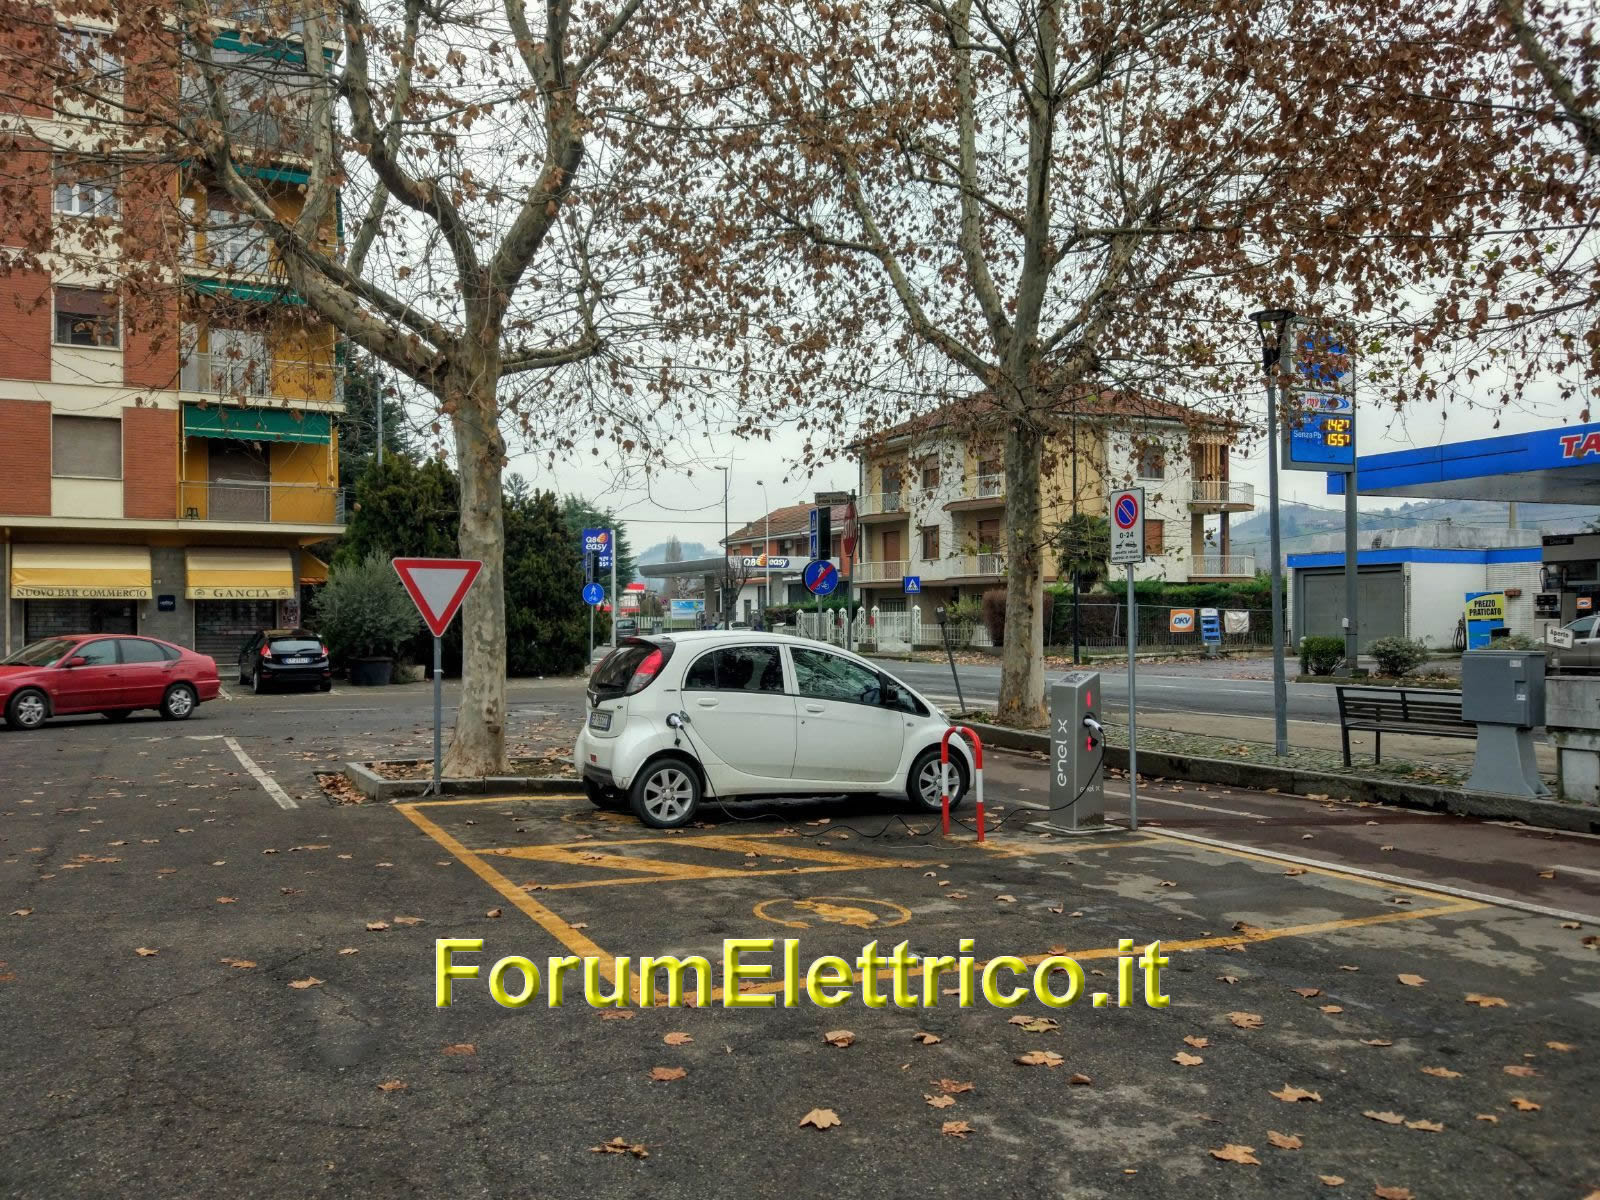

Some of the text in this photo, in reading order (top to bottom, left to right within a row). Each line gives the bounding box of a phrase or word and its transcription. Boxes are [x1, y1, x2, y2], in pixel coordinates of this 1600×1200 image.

[1293, 430, 1322, 439] Senza Pb
[1119, 531, 1134, 539] 0-24
[585, 543, 607, 553] easy
[743, 558, 787, 568] Q8 easy
[17, 588, 147, 597] NUOVO BAR COMMERCIO
[213, 588, 270, 598] GANCIA
[1474, 599, 1496, 607] PREZZO
[1469, 608, 1502, 616] PRATICATO
[1174, 617, 1191, 625] DKV
[1056, 740, 1068, 787] enel
